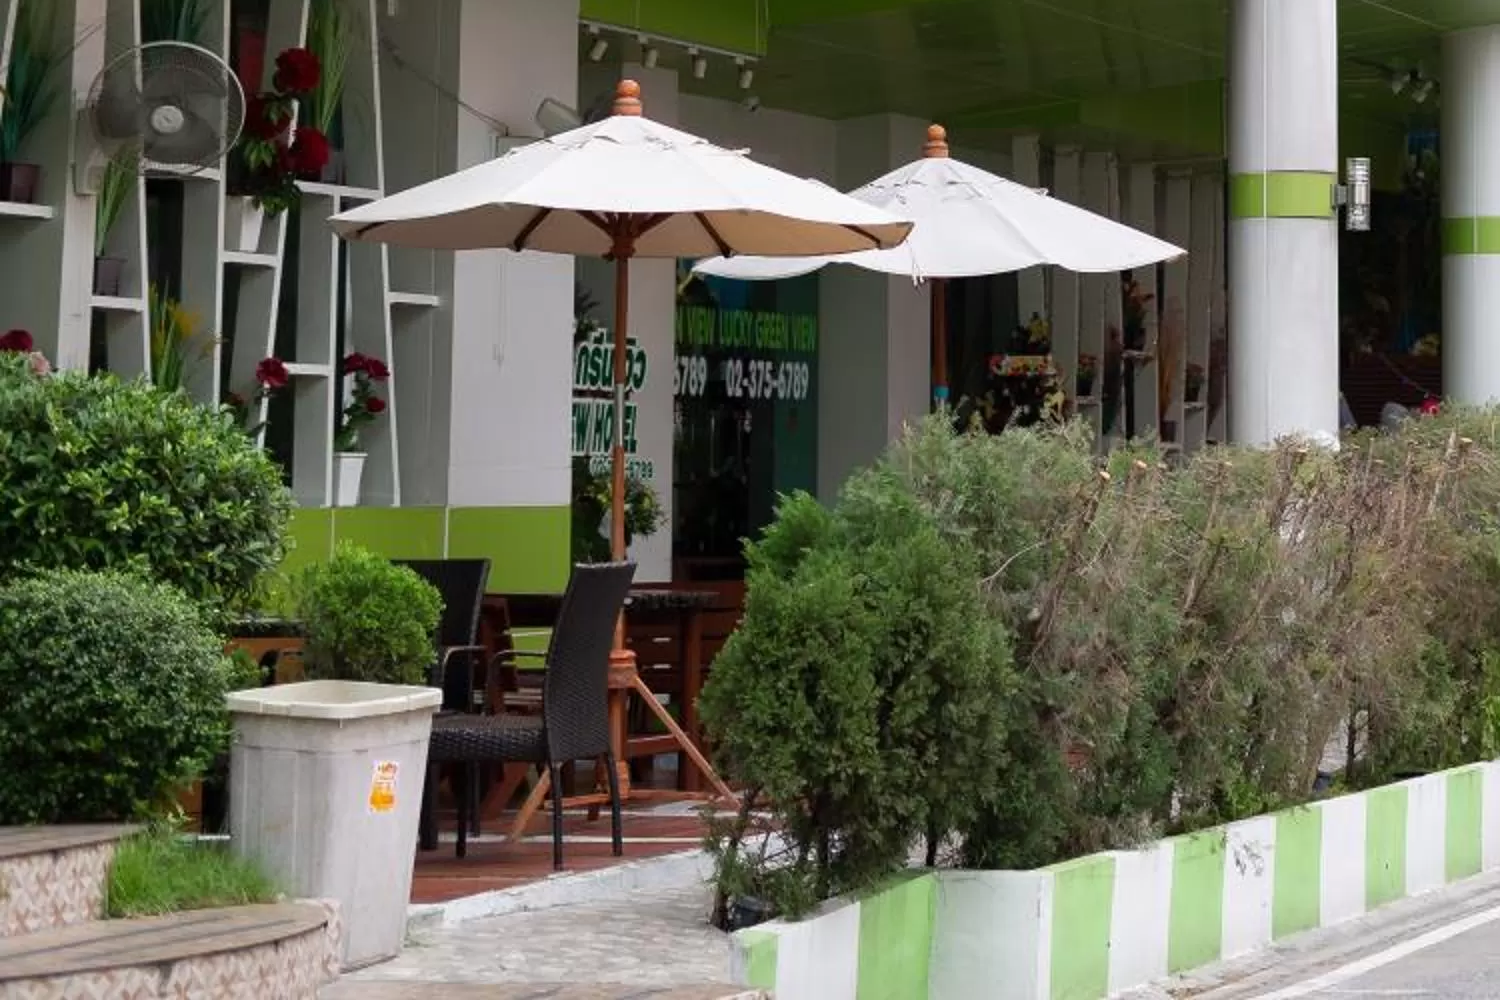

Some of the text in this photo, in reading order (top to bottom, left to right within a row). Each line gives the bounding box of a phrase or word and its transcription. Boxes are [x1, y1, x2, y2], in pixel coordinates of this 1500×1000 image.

[720, 310, 753, 348] LUCKY
[755, 311, 789, 351] GREEN
[725, 357, 810, 400] 02-375-6789
[592, 402, 637, 454] HOEL
